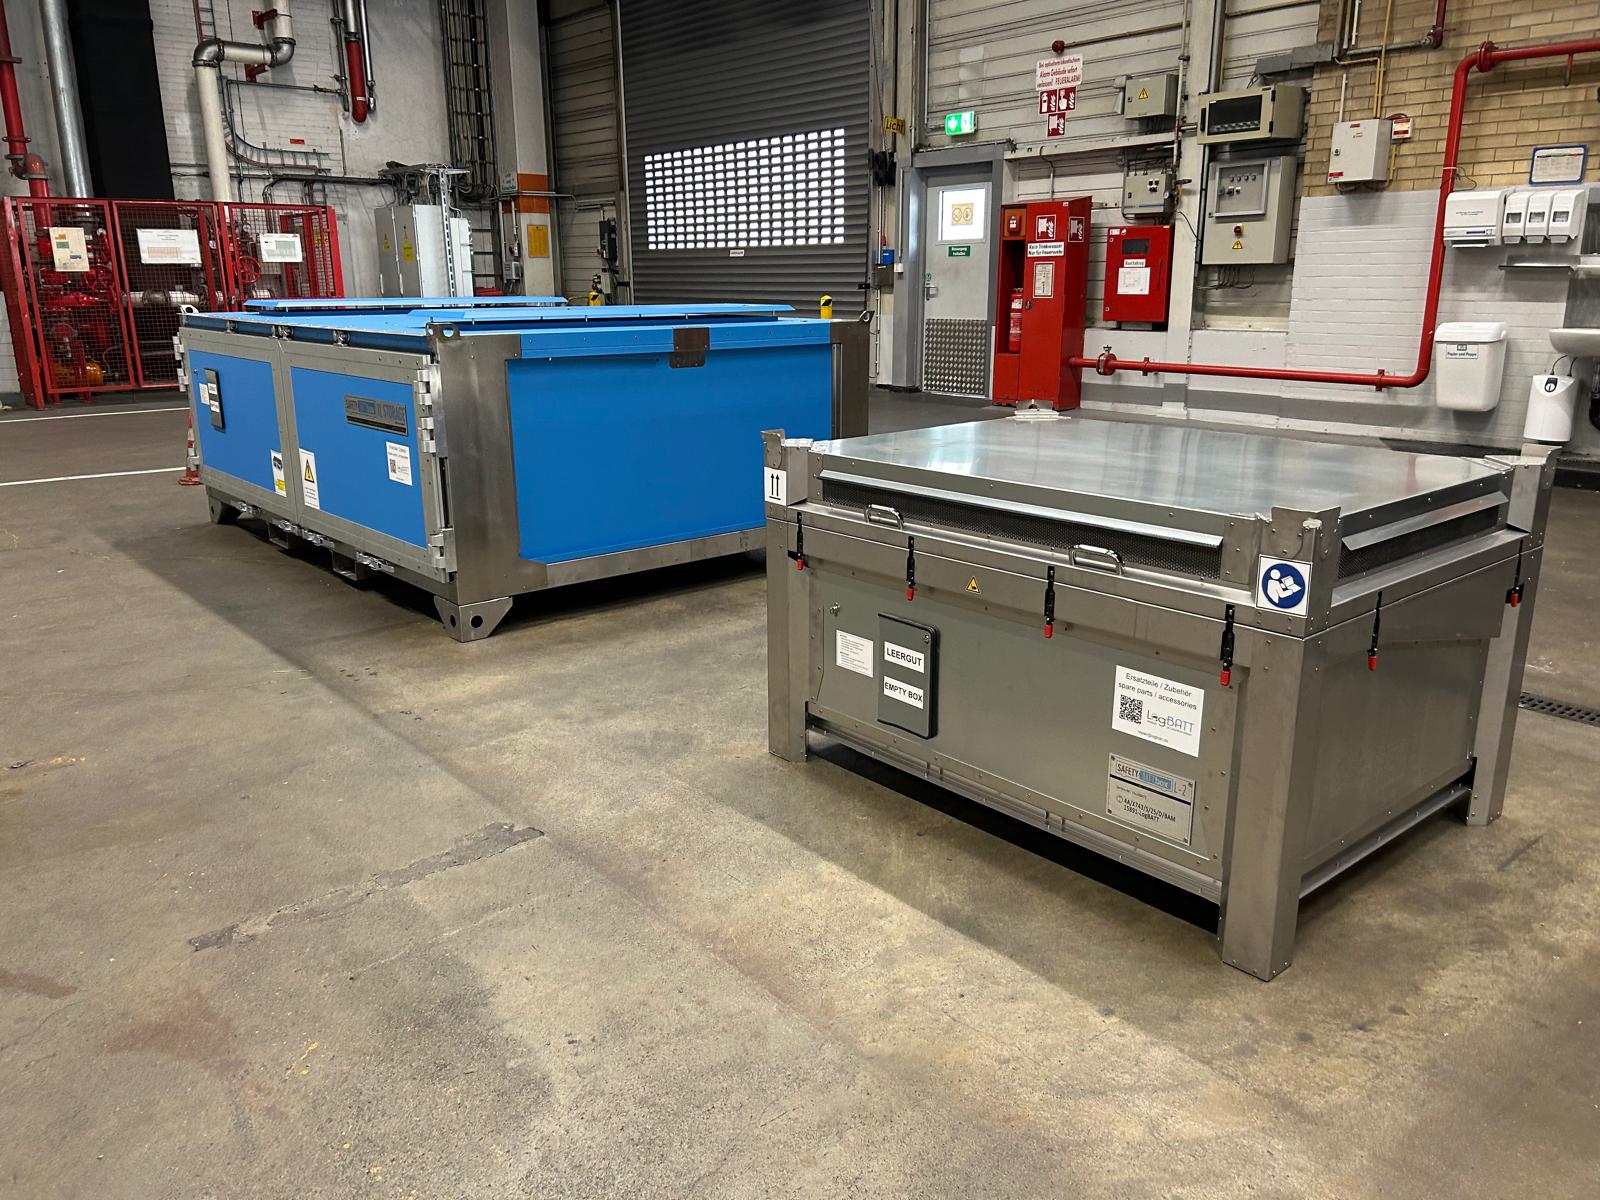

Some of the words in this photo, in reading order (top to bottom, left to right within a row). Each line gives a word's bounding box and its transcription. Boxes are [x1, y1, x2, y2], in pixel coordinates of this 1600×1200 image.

[1051, 68, 1067, 77] Gebäude
[886, 118, 905, 132] Licht
[886, 647, 922, 666] LEERGUT
[884, 681, 907, 696] EMPTY
[907, 690, 923, 703] BOX
[1126, 672, 1159, 688] Ersatzteile
[1164, 683, 1192, 697] Zubehör
[1118, 682, 1136, 693] spare
[1136, 687, 1153, 698] parts
[1158, 694, 1197, 710] accessories
[1117, 763, 1139, 777] SAFETY
